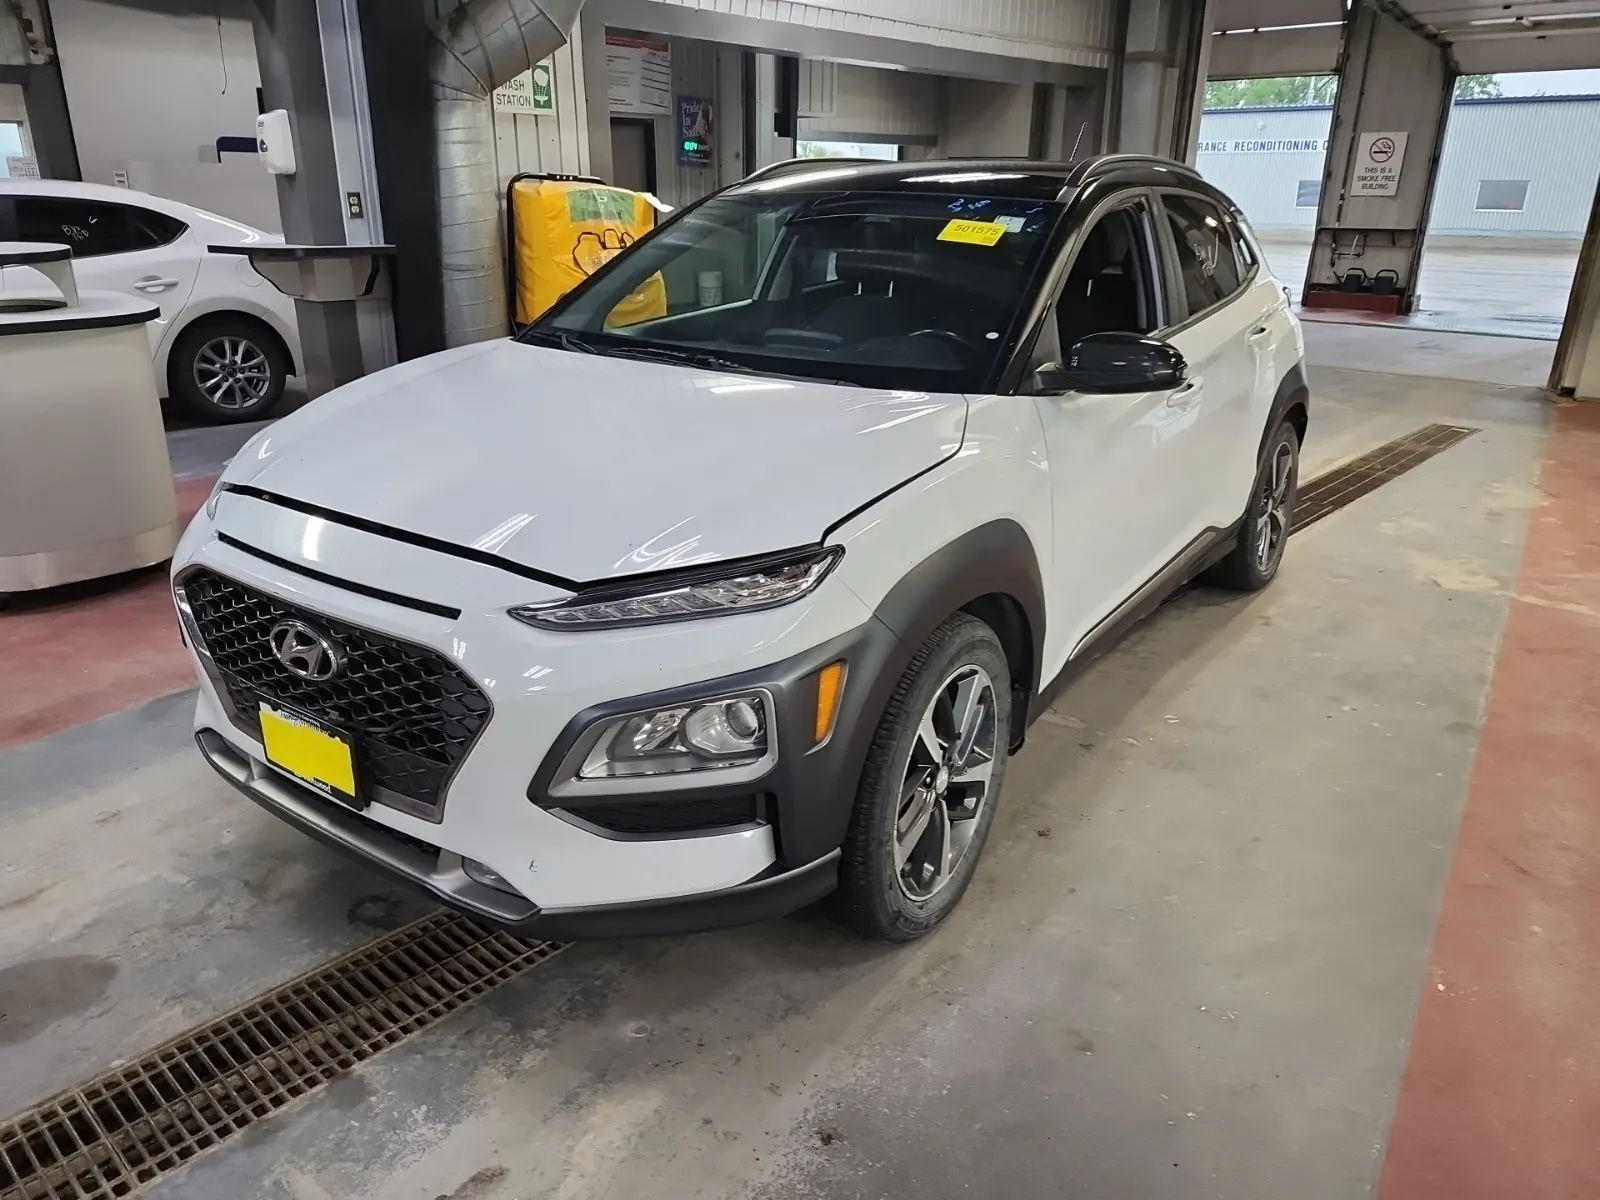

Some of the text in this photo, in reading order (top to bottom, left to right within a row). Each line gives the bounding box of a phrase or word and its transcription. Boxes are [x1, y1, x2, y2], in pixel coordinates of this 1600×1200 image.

[496, 93, 531, 107] STATION
[1233, 139, 1318, 151] RECONDITIONING
[953, 224, 1001, 236] 501575
